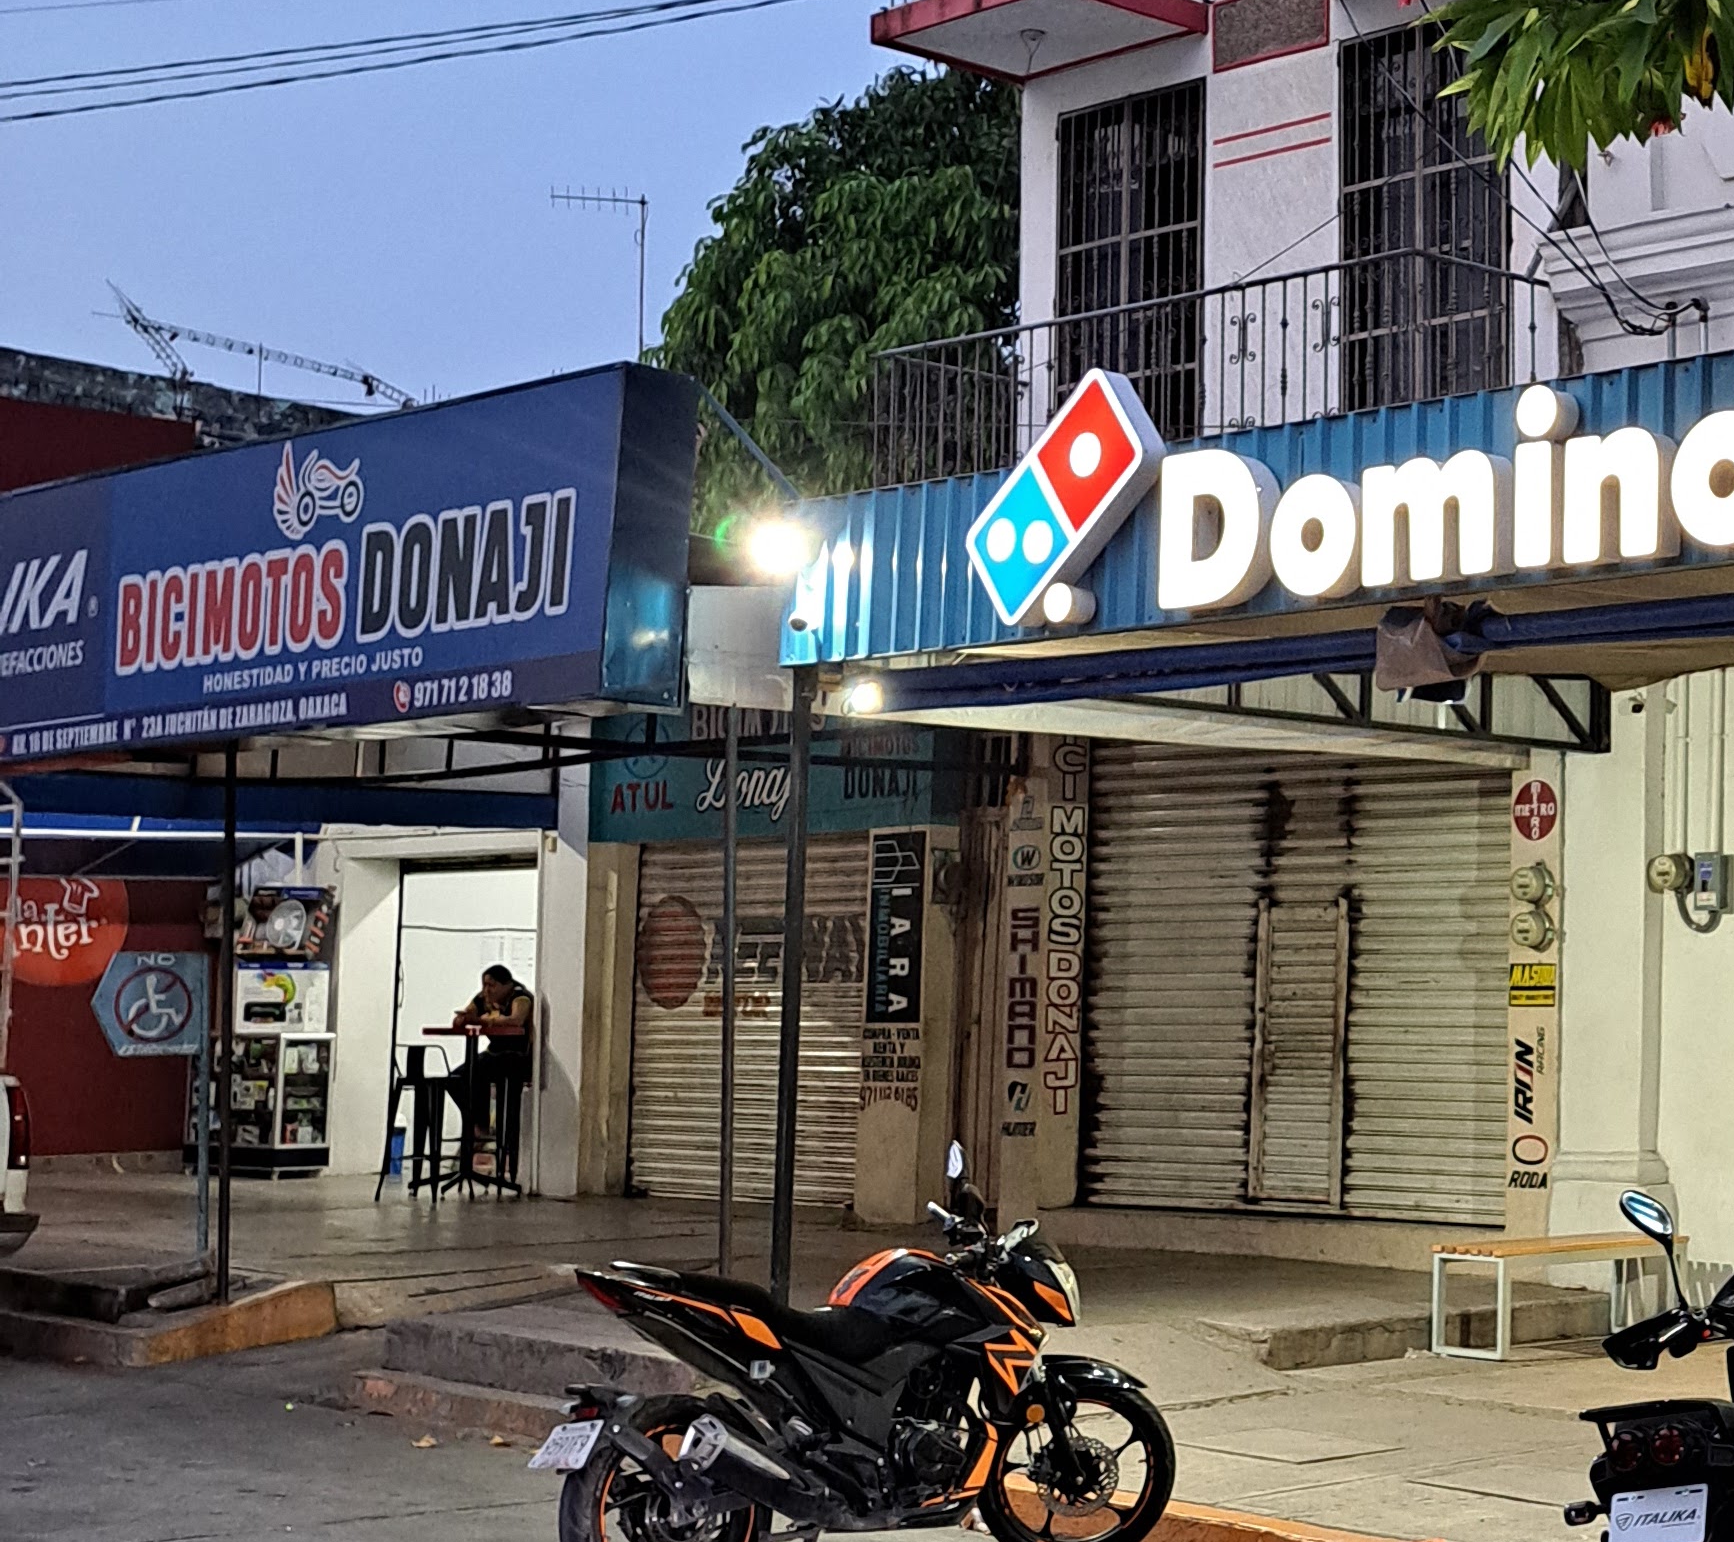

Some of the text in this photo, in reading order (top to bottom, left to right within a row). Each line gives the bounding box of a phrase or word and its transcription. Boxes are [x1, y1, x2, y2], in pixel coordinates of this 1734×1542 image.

[356, 487, 577, 645] DONAJI
[115, 539, 349, 676] BICIMOTOS
[203, 647, 423, 694] HONESTIDAD Y PRECIO JUSTO
[218, 706, 234, 731] DE
[235, 698, 297, 729] ZARAGOZA,
[298, 692, 347, 722] OAXACA
[611, 781, 673, 813] ATUL
[1514, 804, 1555, 817] METRO
[13, 903, 99, 960] nter
[875, 889, 890, 1012] INMOBILIARIA
[888, 887, 912, 1013] IARA
[137, 954, 176, 966] NO
[1006, 909, 1040, 1068] SHIMANO
[900, 1041, 905, 1054] Y
[1044, 949, 1081, 1115] DONAJI
[1514, 1038, 1534, 1124] IRON
[1508, 1170, 1548, 1188] RODA
[1633, 1508, 1697, 1527] ITALIKA
